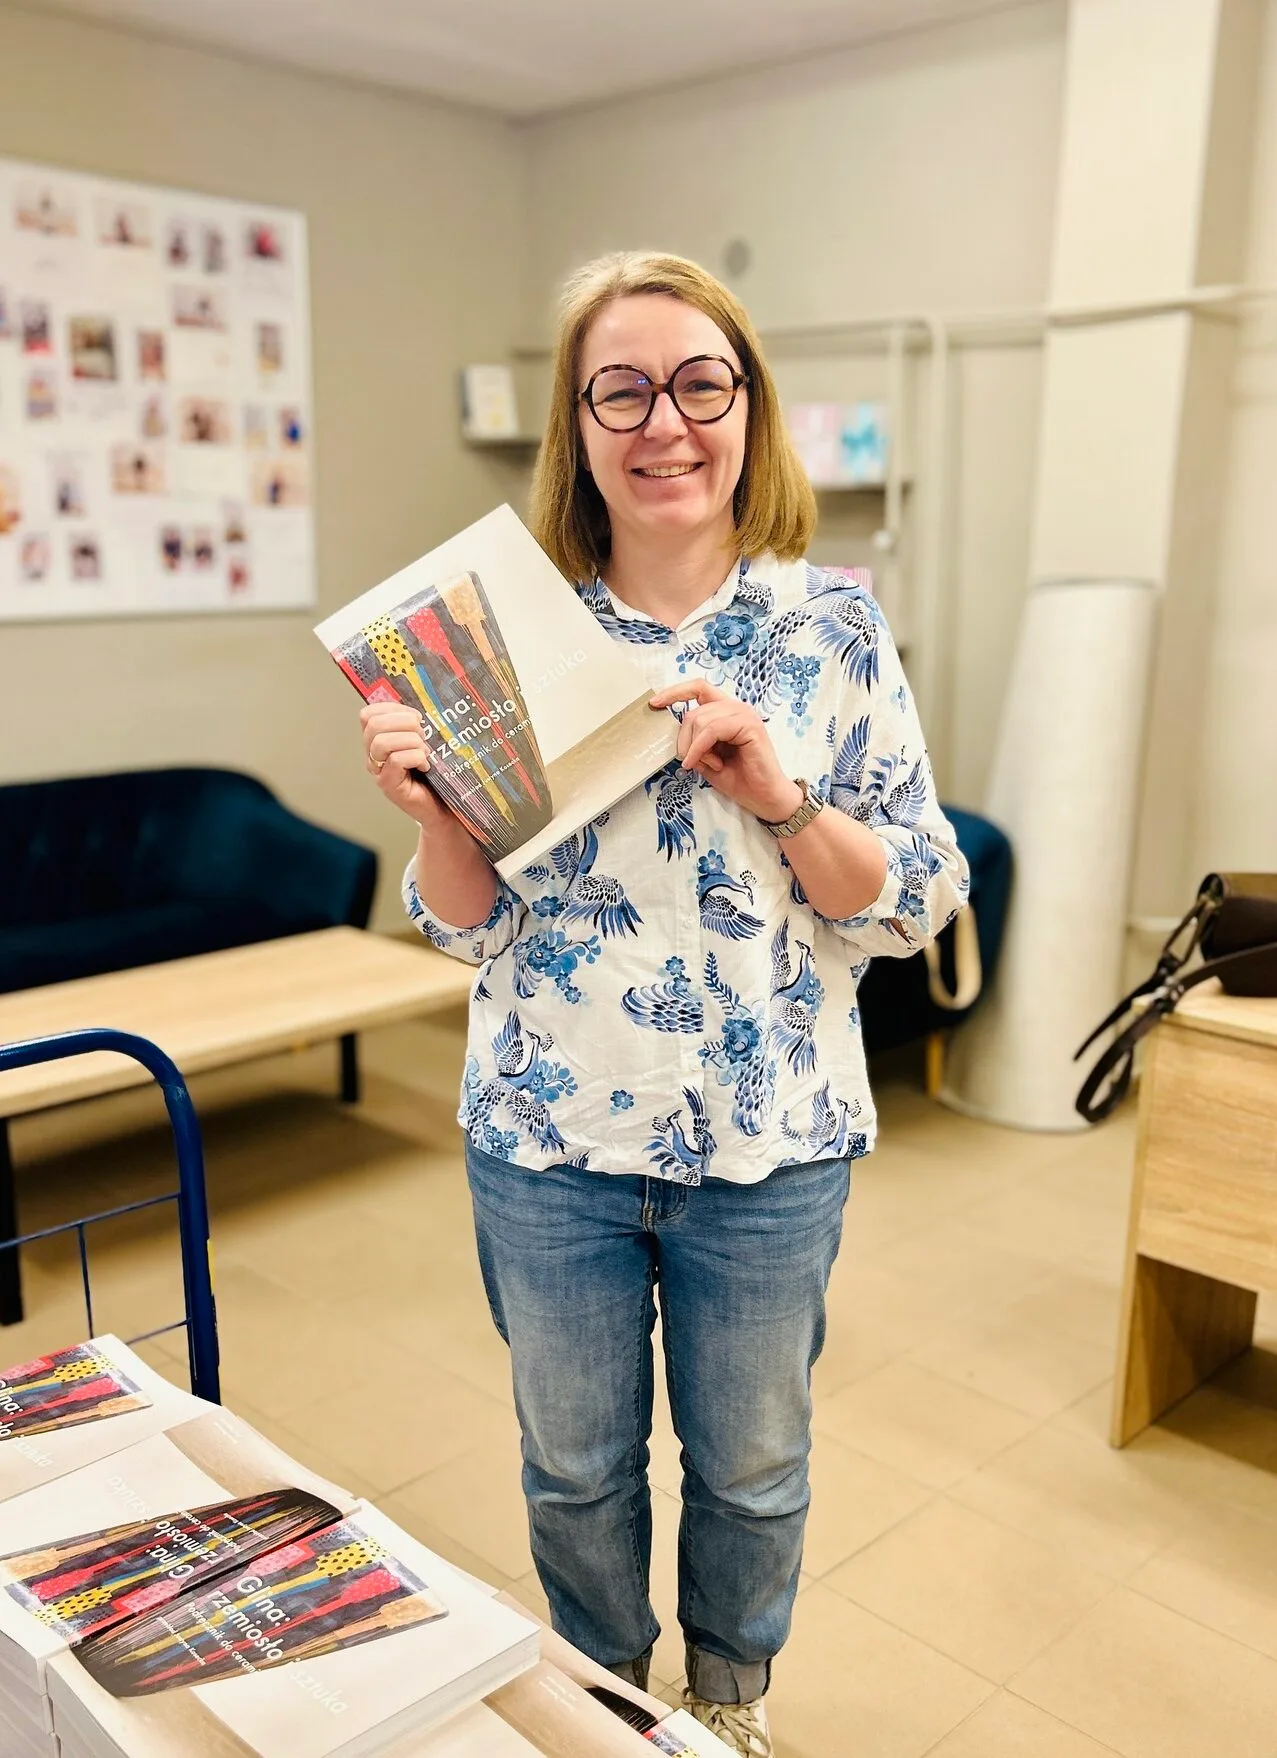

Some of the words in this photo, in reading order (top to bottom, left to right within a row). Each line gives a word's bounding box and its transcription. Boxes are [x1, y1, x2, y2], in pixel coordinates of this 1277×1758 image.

[428, 699, 517, 764] rzemiosło
[531, 649, 589, 694] sztuka
[443, 744, 492, 780] Podręcznik
[491, 737, 504, 749] do
[146, 1544, 195, 1579] Glina:
[154, 1520, 224, 1565] rzemiosło
[236, 1576, 290, 1627] Glina:
[187, 1602, 224, 1641] Podręcznik
[220, 1639, 234, 1650] do
[207, 1590, 283, 1660] rzemiosło
[291, 1671, 350, 1712] sztuka
